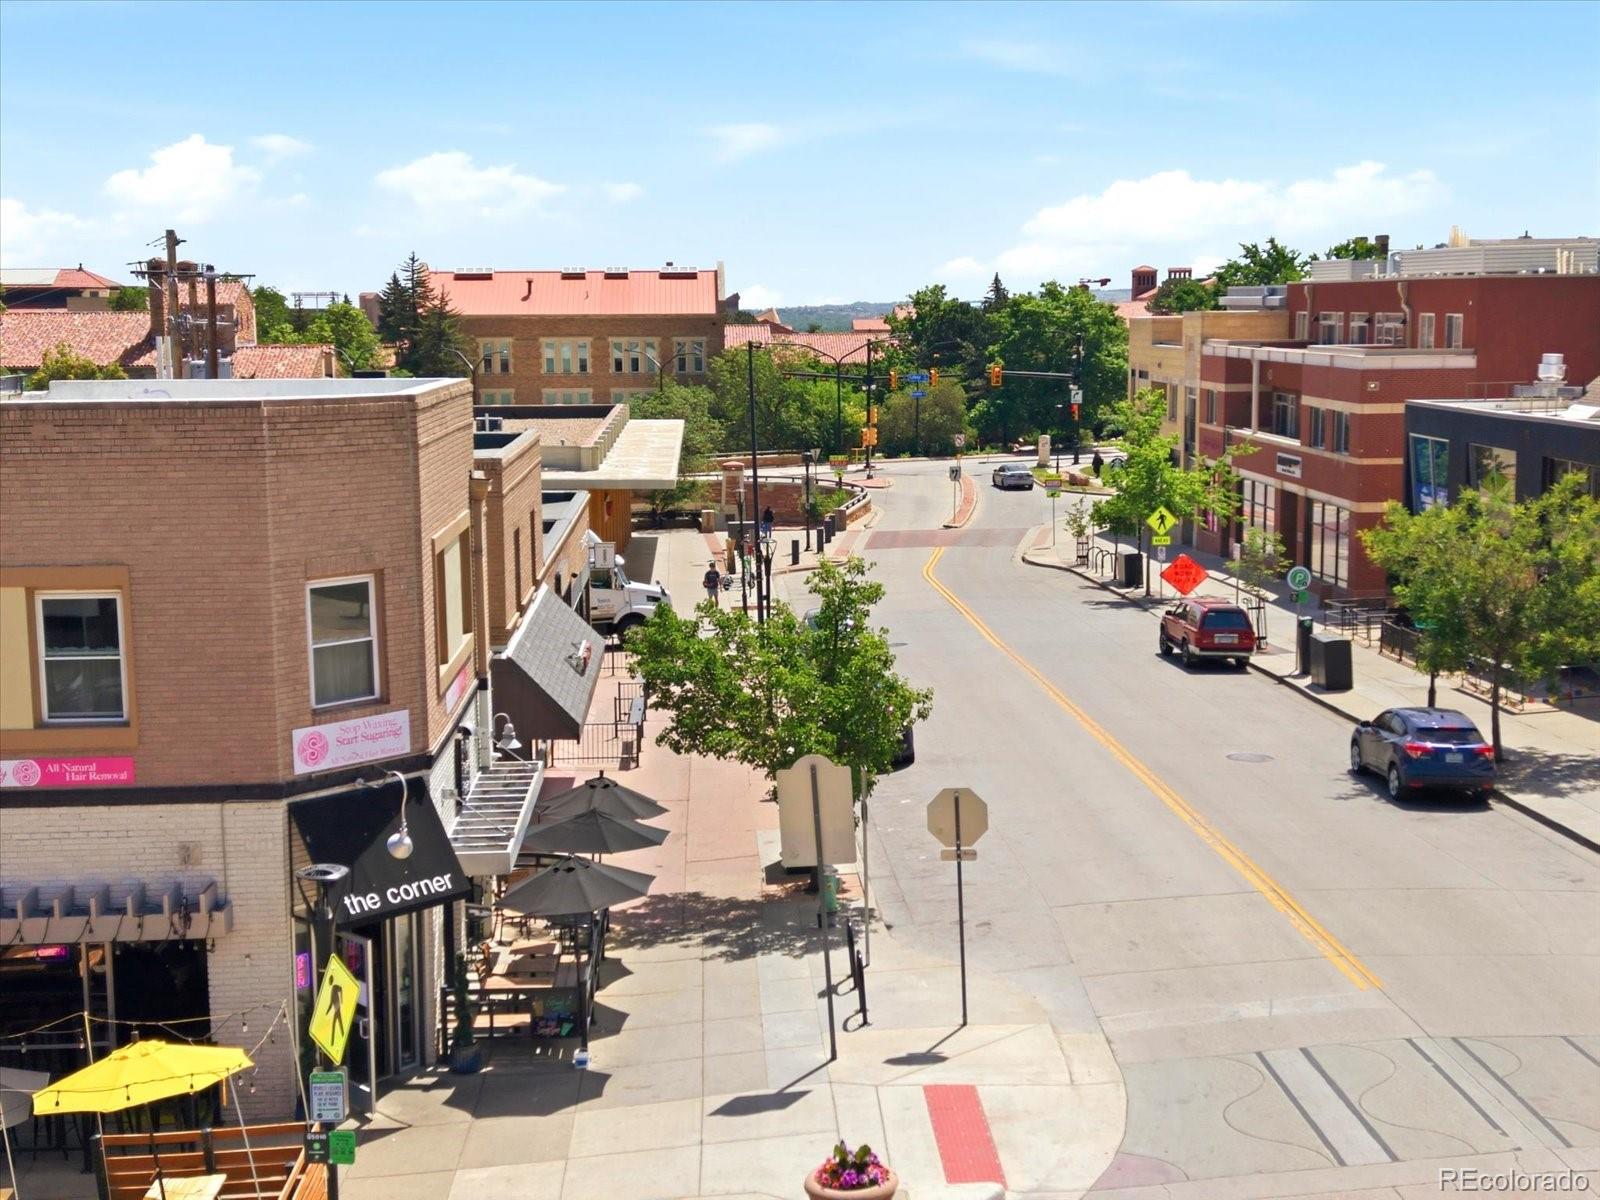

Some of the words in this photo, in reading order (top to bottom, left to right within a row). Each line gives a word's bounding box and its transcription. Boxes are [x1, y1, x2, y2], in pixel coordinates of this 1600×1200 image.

[335, 735, 360, 746] Start
[361, 726, 402, 743] Sugaring!
[45, 763, 59, 773] All
[61, 762, 97, 773] Natural
[65, 772, 86, 782] Hair
[88, 770, 128, 781] Removal
[343, 893, 382, 915] the
[386, 873, 453, 904] corner
